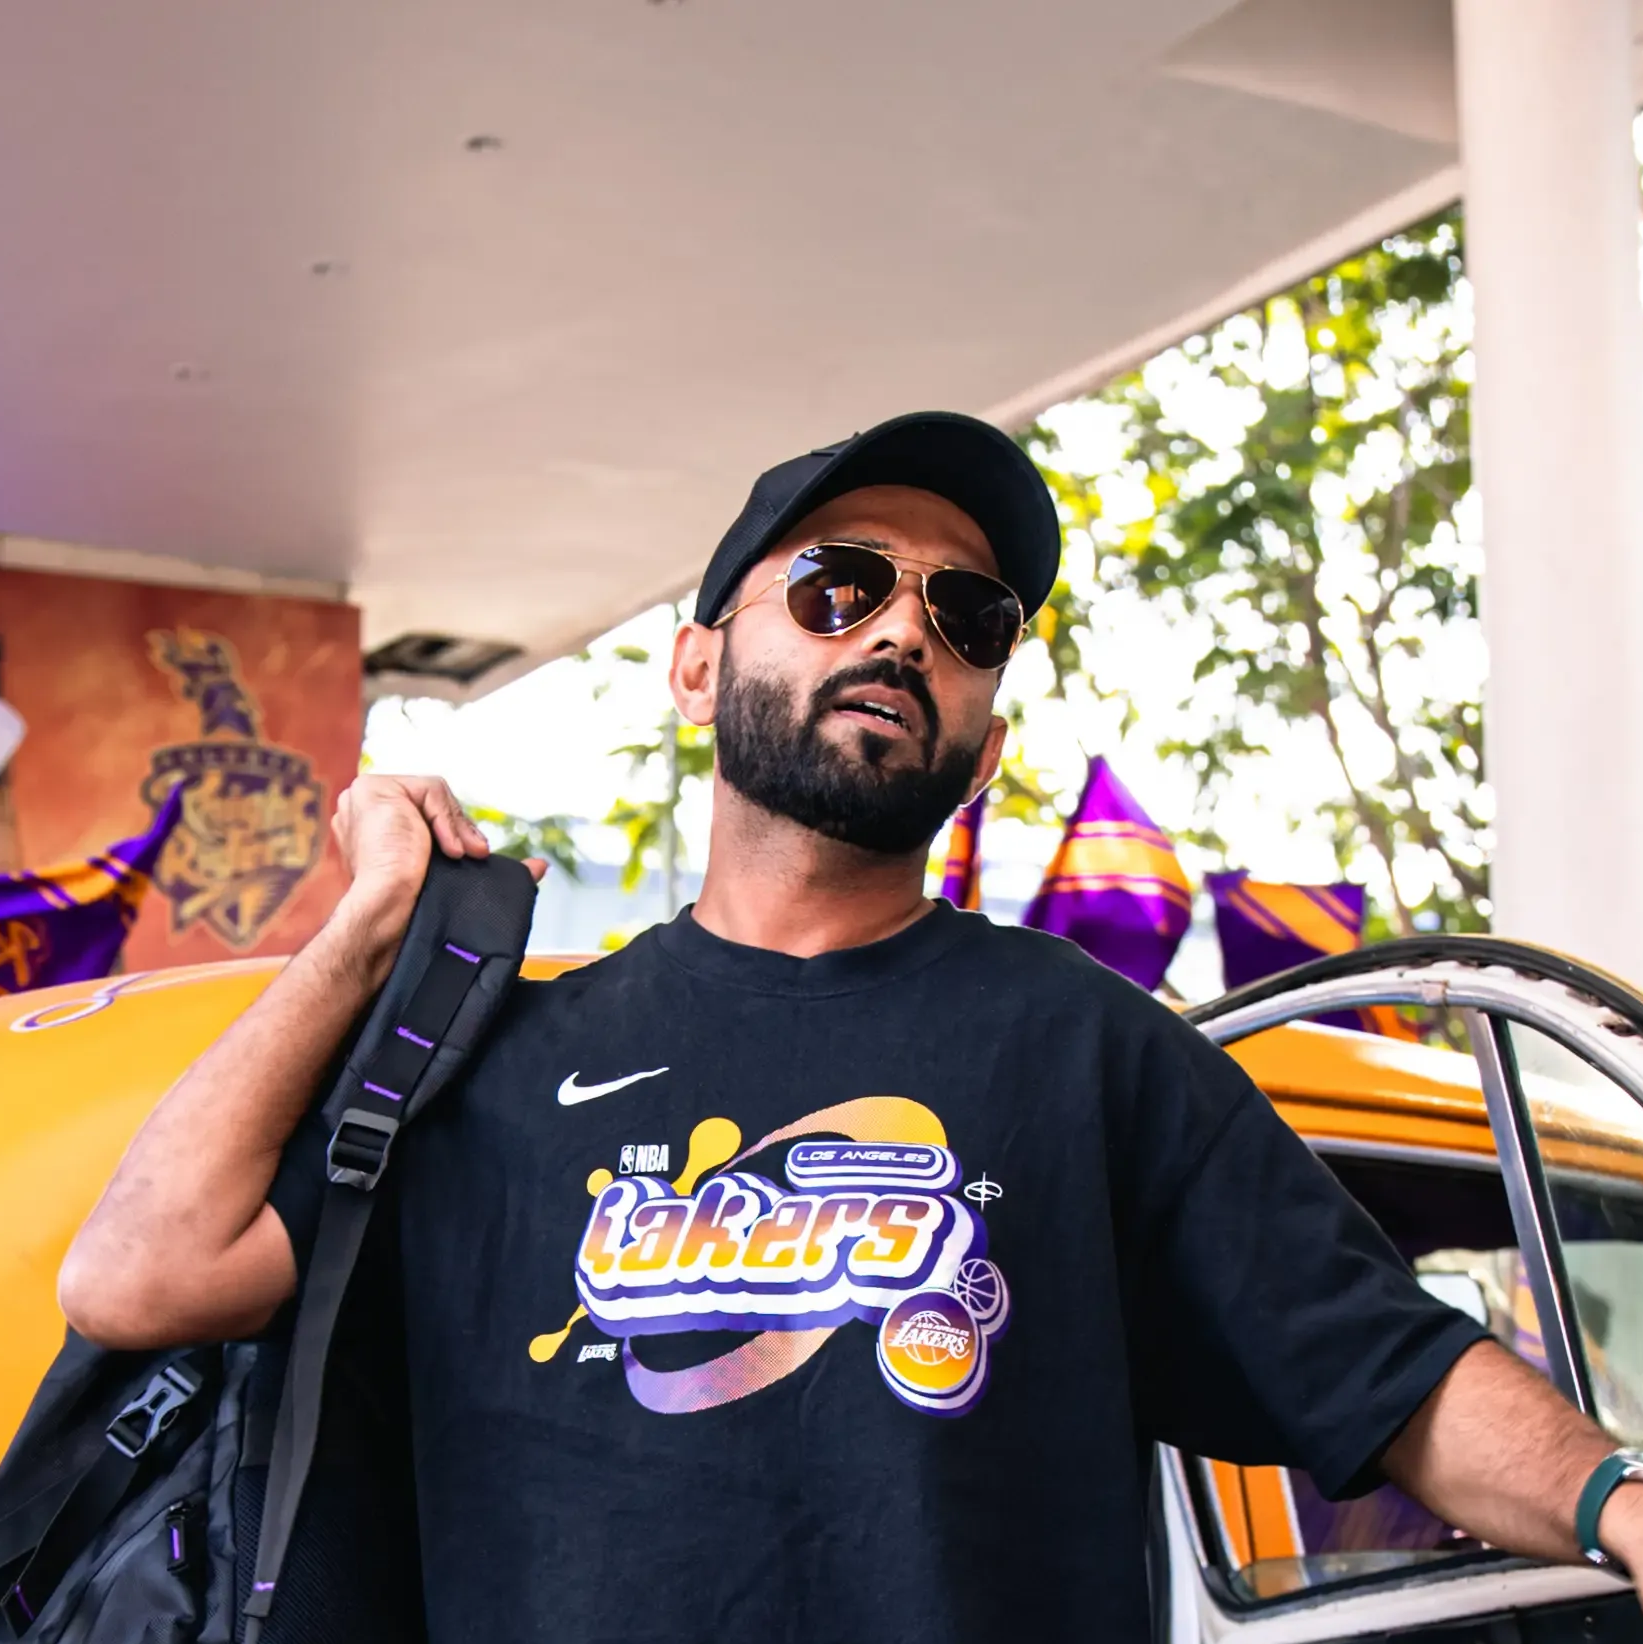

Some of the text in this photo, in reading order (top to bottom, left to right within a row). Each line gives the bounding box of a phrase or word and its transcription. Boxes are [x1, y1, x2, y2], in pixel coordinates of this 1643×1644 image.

[635, 1144, 669, 1172] NBA
[797, 1151, 931, 1164] LOS ANGELES
[887, 1321, 970, 1359] LAKERS
